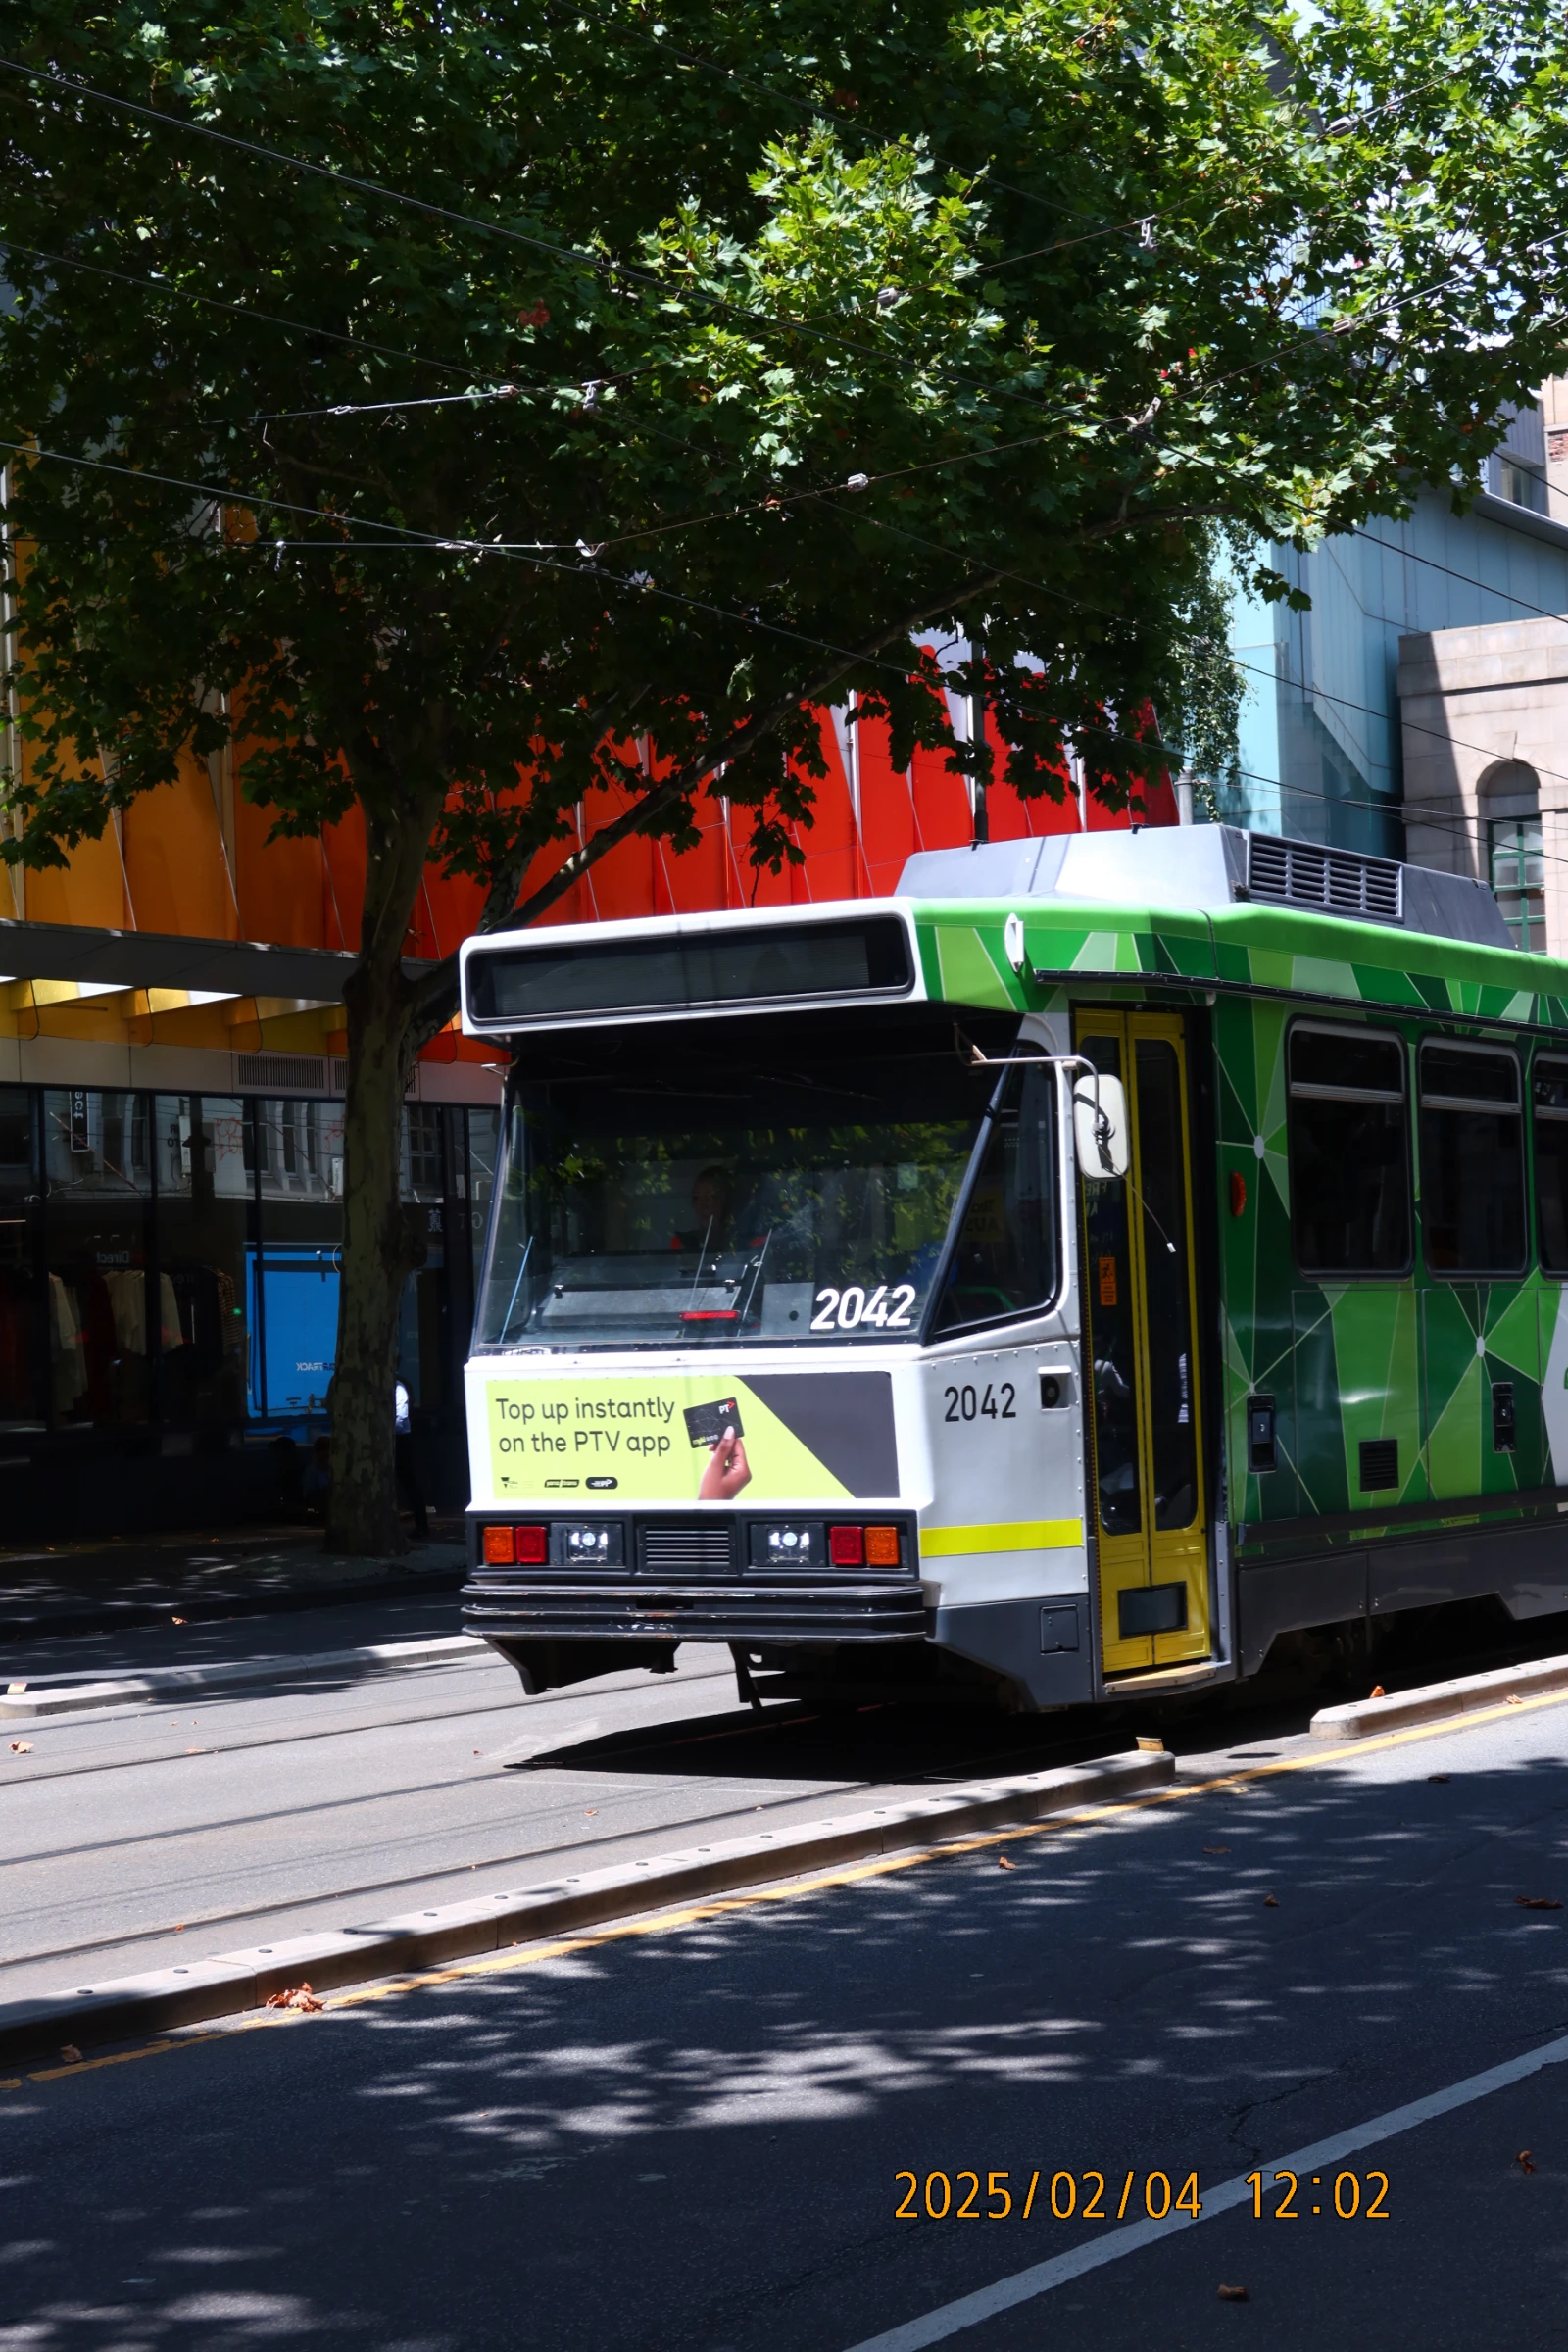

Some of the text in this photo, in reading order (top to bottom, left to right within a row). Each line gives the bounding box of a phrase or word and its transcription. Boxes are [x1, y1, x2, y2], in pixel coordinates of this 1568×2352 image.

[810, 1285, 916, 1330] 2042
[495, 1396, 675, 1424] Top up instantly
[944, 1382, 1016, 1423] 2042
[499, 1430, 671, 1457] on the PTV app
